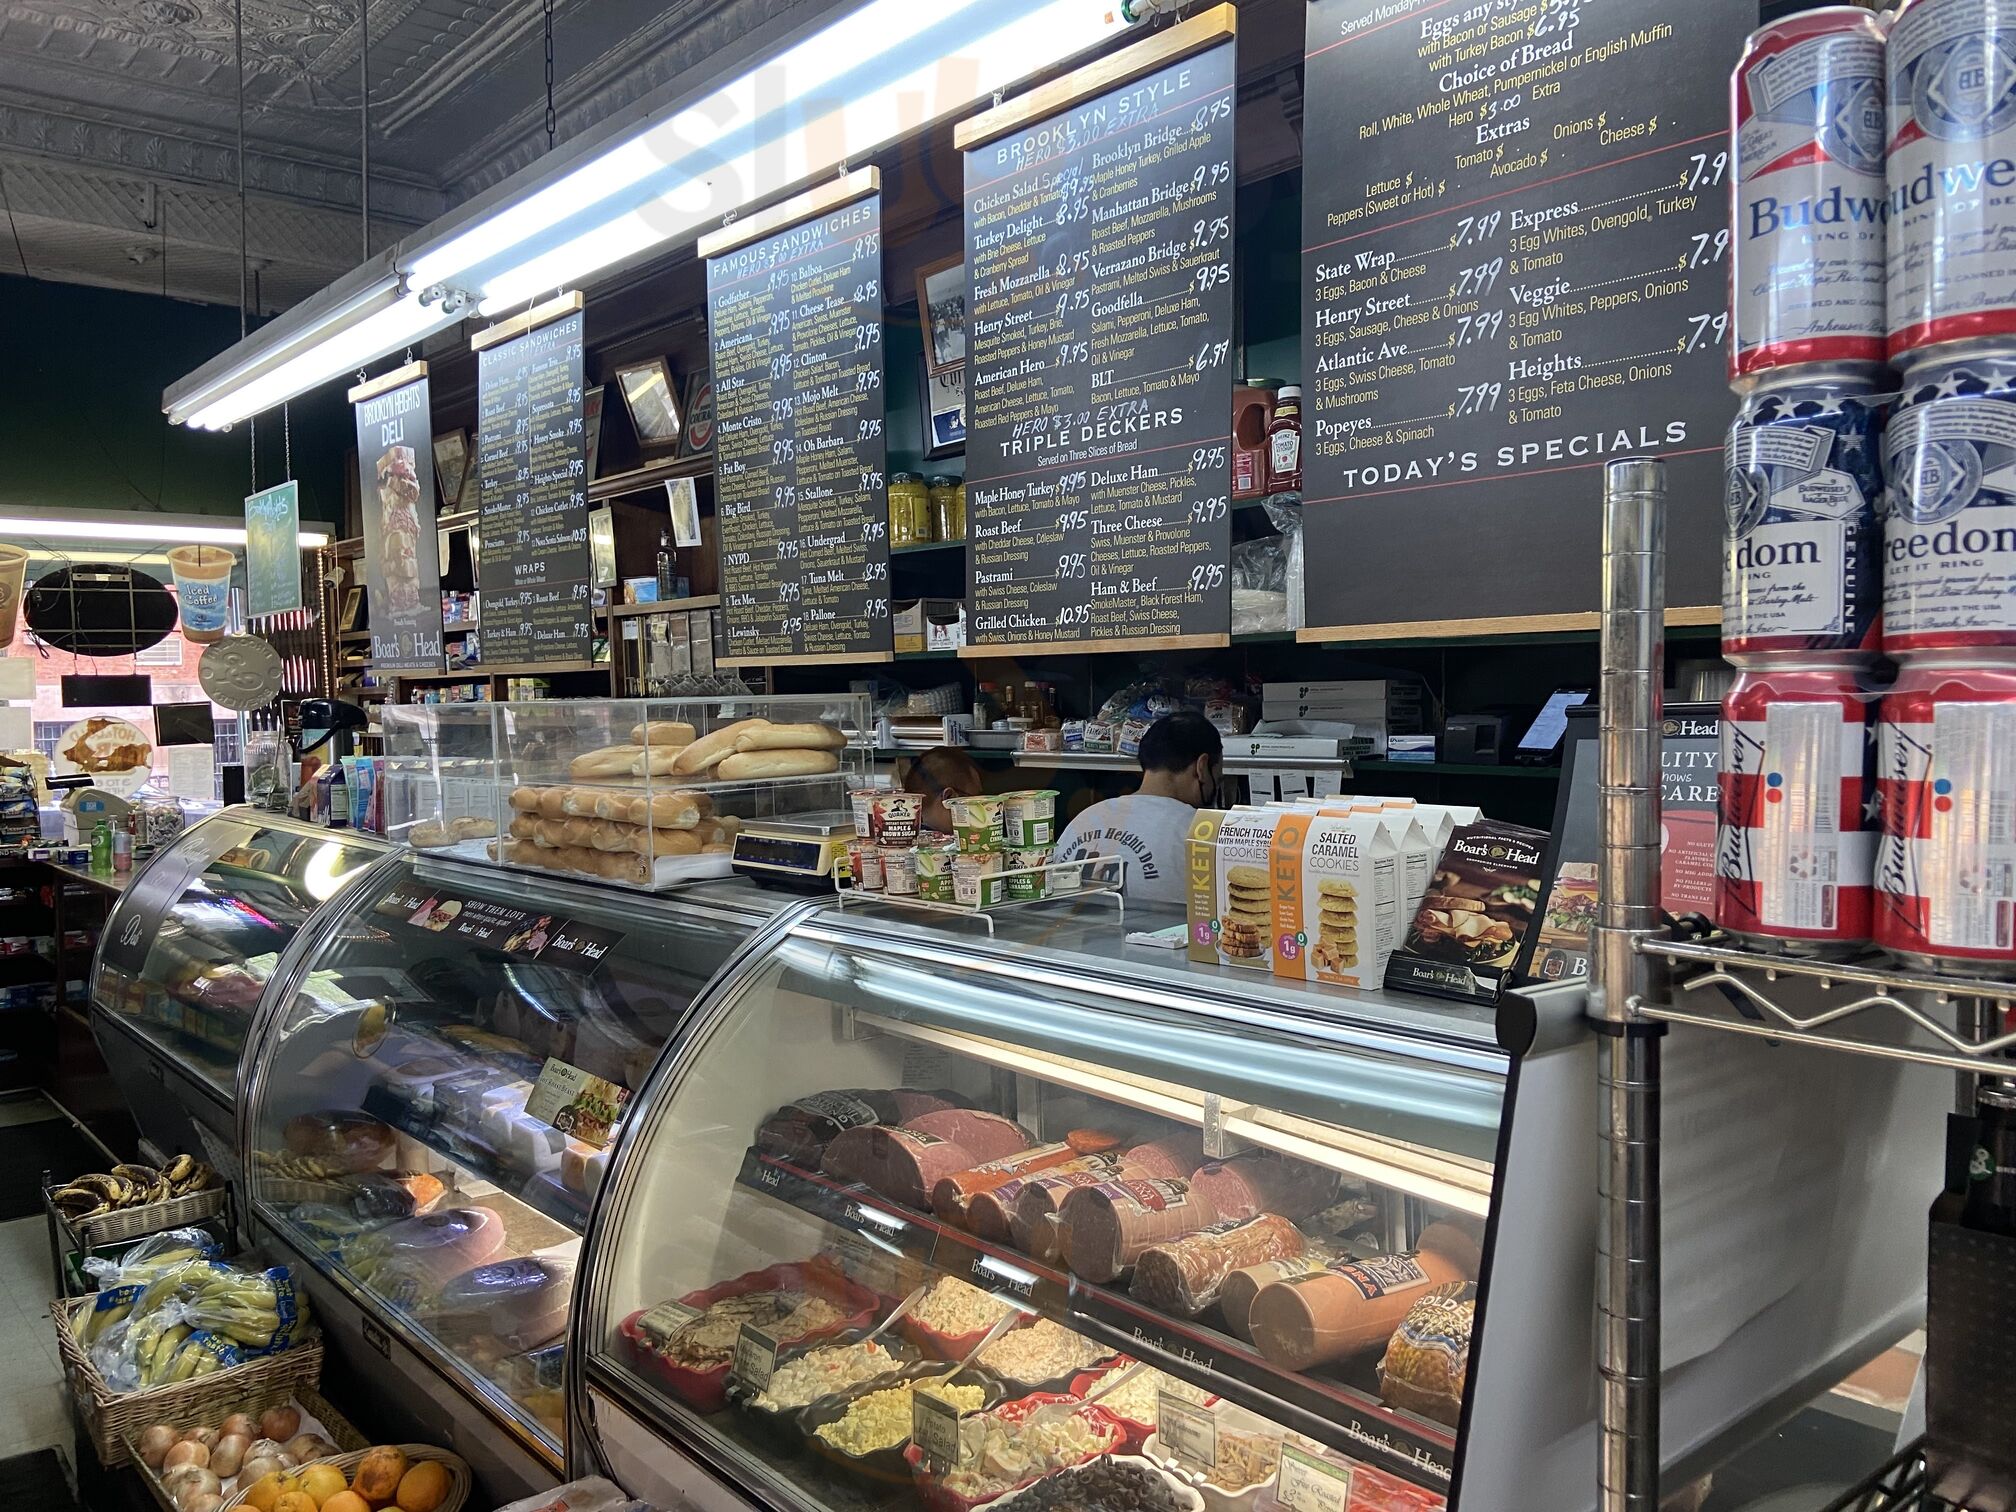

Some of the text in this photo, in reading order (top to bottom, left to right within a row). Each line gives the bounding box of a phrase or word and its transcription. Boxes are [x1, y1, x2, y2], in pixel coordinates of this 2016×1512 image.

[1341, 12, 1373, 36] Served
[1420, 11, 1459, 41] Eggs
[1442, 5, 1537, 49] Bacon Sausage
[1439, 30, 1574, 93] Choice Bread
[1454, 42, 1487, 65] Turkey
[1417, 22, 1673, 121] Whole Wheat, Pumpernickel English Muffin
[997, 69, 1191, 165] BROOKLYN STYLE
[1449, 109, 1473, 127] Hero
[1553, 117, 1593, 140] Onions
[1475, 115, 1530, 144] Extras
[1600, 123, 1644, 146] Cheese
[1092, 141, 1141, 170] Brooklyn
[1455, 147, 1493, 169] Tomato
[1490, 153, 1537, 178] Avocado
[1366, 176, 1401, 197] Lettuce
[1092, 182, 1189, 225] Manhattan Bridge
[1328, 202, 1364, 227] Peppers
[1656, 195, 1697, 216] Turkey
[1510, 201, 1578, 231] Express
[713, 206, 871, 278] FAMOUS SANDWICHES
[974, 217, 1043, 250] Turkey Delight
[800, 263, 822, 278] Balboa
[1092, 241, 1186, 279] Verrazano Bridge
[1316, 261, 1352, 283] State
[1355, 249, 1396, 278] Wrap
[1000, 267, 1050, 291] Mozzarella
[718, 289, 750, 308] Godfather
[1510, 278, 1571, 306] Veggie
[800, 295, 845, 317] Cheese Tease
[1091, 294, 1143, 318] Goodfella
[1316, 293, 1411, 327] Henry Street
[482, 320, 578, 367] CLASSIC SANDWICHES
[720, 334, 752, 350] Americana
[801, 352, 827, 365] Clinton
[1315, 348, 1375, 373] Atlantic
[1508, 354, 1582, 381] Heights
[974, 359, 1045, 386] American Hero
[1092, 369, 1115, 388] BLT
[364, 392, 394, 426] BROOKLYN
[1325, 389, 1379, 409] Mushrooms
[722, 416, 762, 434] Monte Cristo
[1012, 416, 1048, 438] HERO
[1097, 399, 1149, 421] EXTRA
[1316, 414, 1372, 439] Popeyes
[382, 418, 404, 446] DELI
[1000, 407, 1184, 457] TRIPLE DECKERS
[1396, 424, 1434, 445] Spinach
[1497, 421, 1688, 467] SPECIALS
[1091, 471, 1128, 487] Deluxe
[1130, 464, 1159, 479] Ham
[805, 488, 833, 501] Stallone
[1091, 518, 1123, 534] Three
[1125, 515, 1163, 530] Cheese
[808, 532, 846, 550] Undergrad
[514, 561, 545, 575] WRAPS
[727, 552, 750, 565] NYPD
[1916, 562, 1929, 571] IT
[1941, 560, 1984, 568] RING
[809, 571, 845, 583] Tuna Melt
[975, 568, 1014, 584] Pastrami
[1845, 526, 1856, 633] GENUINE
[184, 584, 210, 596] Iced
[184, 594, 219, 605] Coffee
[811, 610, 836, 620] Pallone
[975, 613, 1047, 631] Grilled Chicken
[414, 631, 441, 658] Head
[1680, 721, 1718, 736] Head
[1105, 828, 1146, 854] Heights
[1220, 826, 1251, 837] FRENCH
[1234, 838, 1254, 847] MAPLE
[1319, 833, 1356, 844] SALTED
[1192, 819, 1214, 891] KETO
[1223, 847, 1268, 859] COOKIES
[1312, 844, 1359, 858] CARAMEL
[1505, 849, 1540, 864] Head
[1277, 826, 1300, 902] KETO
[1310, 857, 1359, 871] COOKIES
[465, 901, 486, 910] SHOW
[486, 905, 507, 917] THEM
[507, 909, 526, 921] LOVE
[476, 928, 492, 939] Head
[582, 942, 608, 959] Head
[1445, 969, 1466, 985] Head
[761, 1170, 780, 1187] Head
[1181, 1347, 1212, 1375] Head
[933, 1432, 956, 1449] Salad
